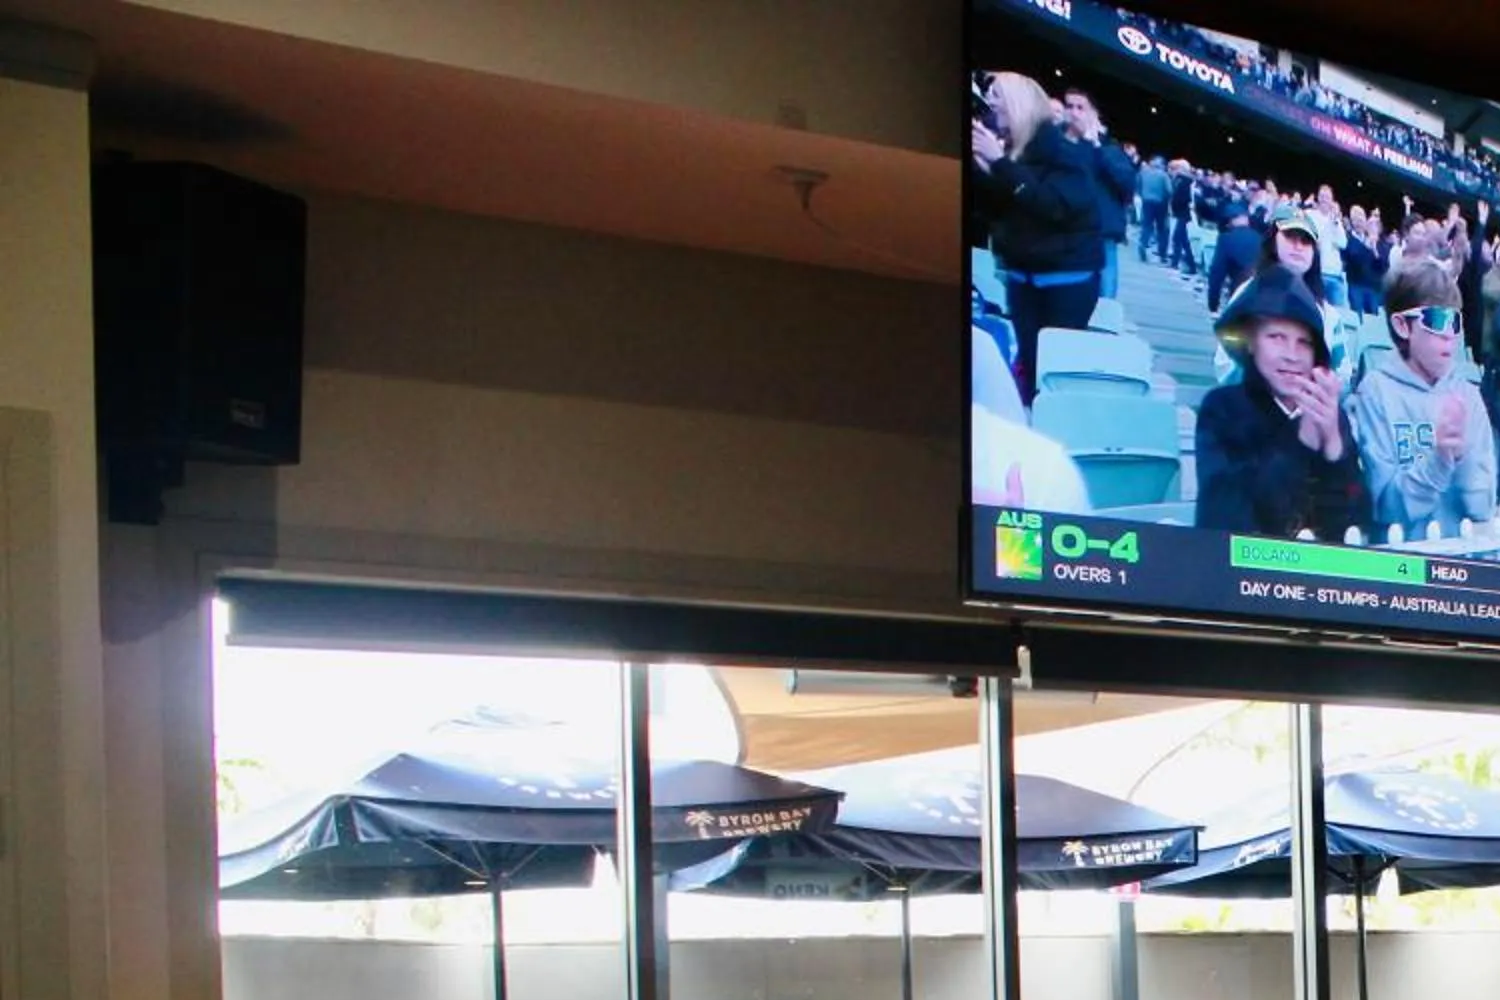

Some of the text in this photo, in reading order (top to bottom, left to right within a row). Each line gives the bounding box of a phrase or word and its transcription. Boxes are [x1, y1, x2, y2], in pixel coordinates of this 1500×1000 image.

[1155, 42, 1236, 95] TOYOTA
[997, 510, 1043, 529] AUS
[1051, 523, 1140, 563] 0-4
[1241, 545, 1408, 575] BOLAND 4
[1053, 563, 1127, 586] OVERS 1
[1431, 565, 1469, 582] HEAD
[1240, 581, 1271, 598] DAY
[1273, 584, 1306, 600] ONE
[1316, 588, 1380, 608] STUMPS
[1389, 595, 1468, 617] AUSTRALIA
[718, 806, 812, 828] BYRON BAY
